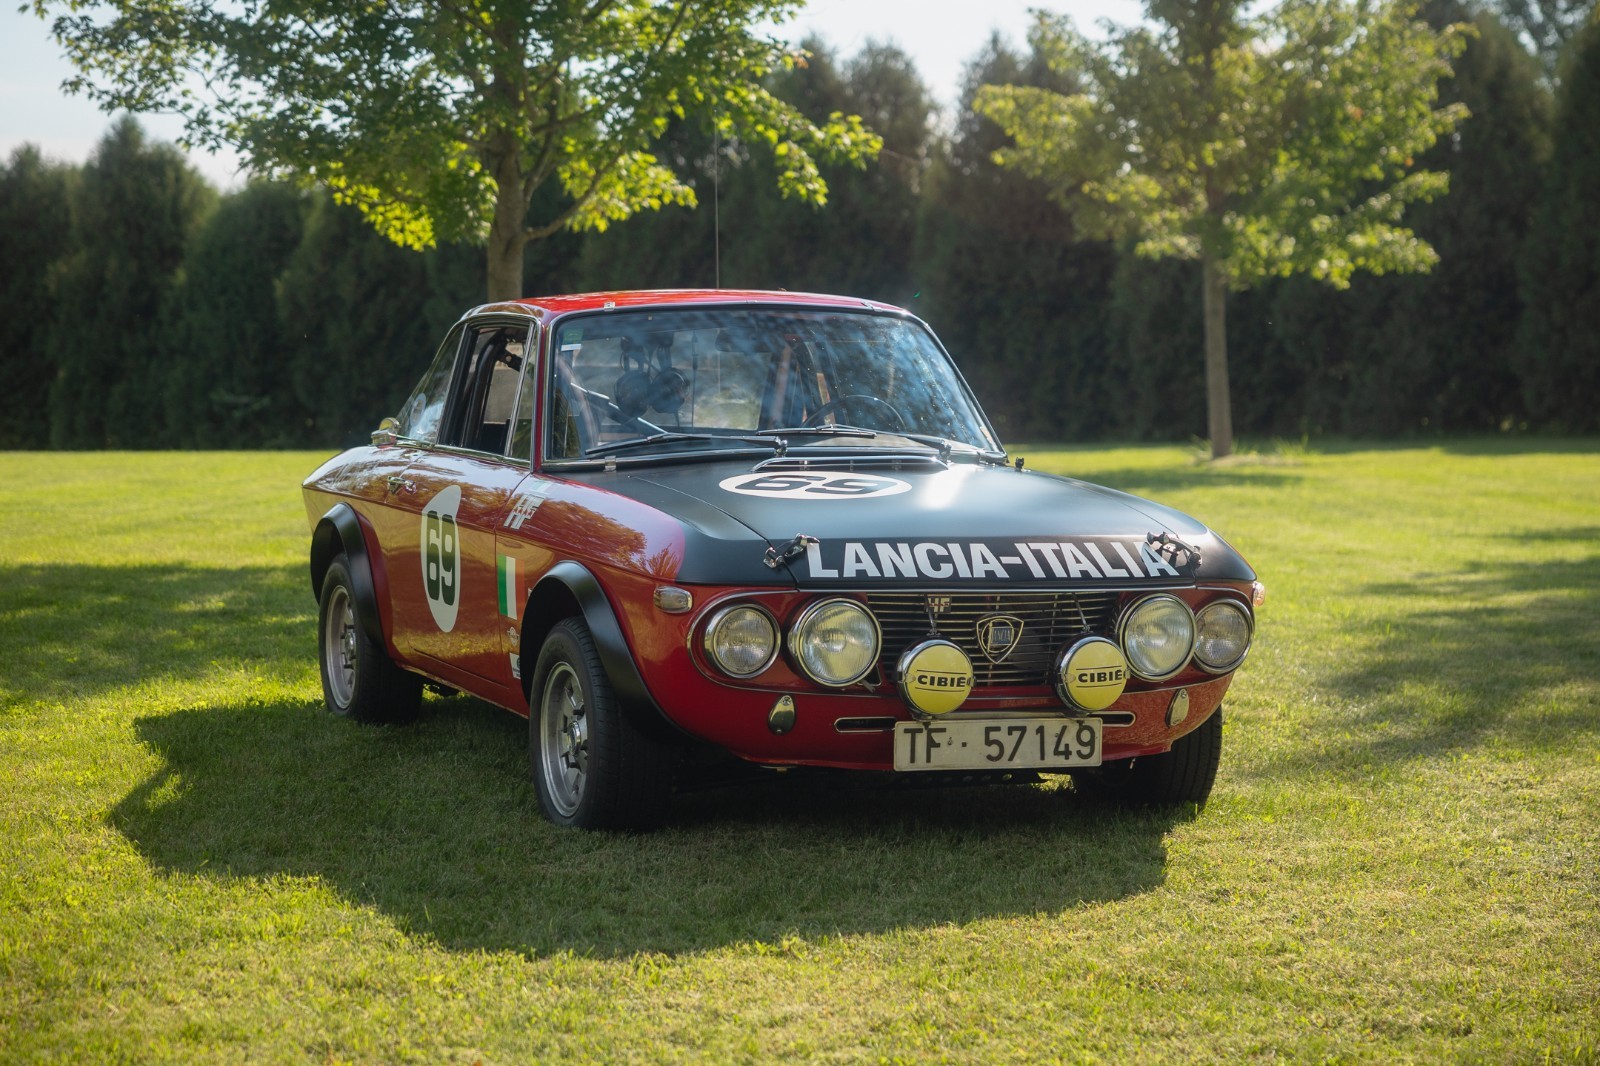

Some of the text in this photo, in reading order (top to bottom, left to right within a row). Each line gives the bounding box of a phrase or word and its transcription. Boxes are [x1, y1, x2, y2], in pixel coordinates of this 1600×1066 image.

[734, 474, 899, 495] 69
[426, 510, 455, 606] 69
[806, 541, 1180, 578] LANCIA-ITALIA
[903, 727, 947, 764] TF
[984, 725, 1096, 763] 57149
